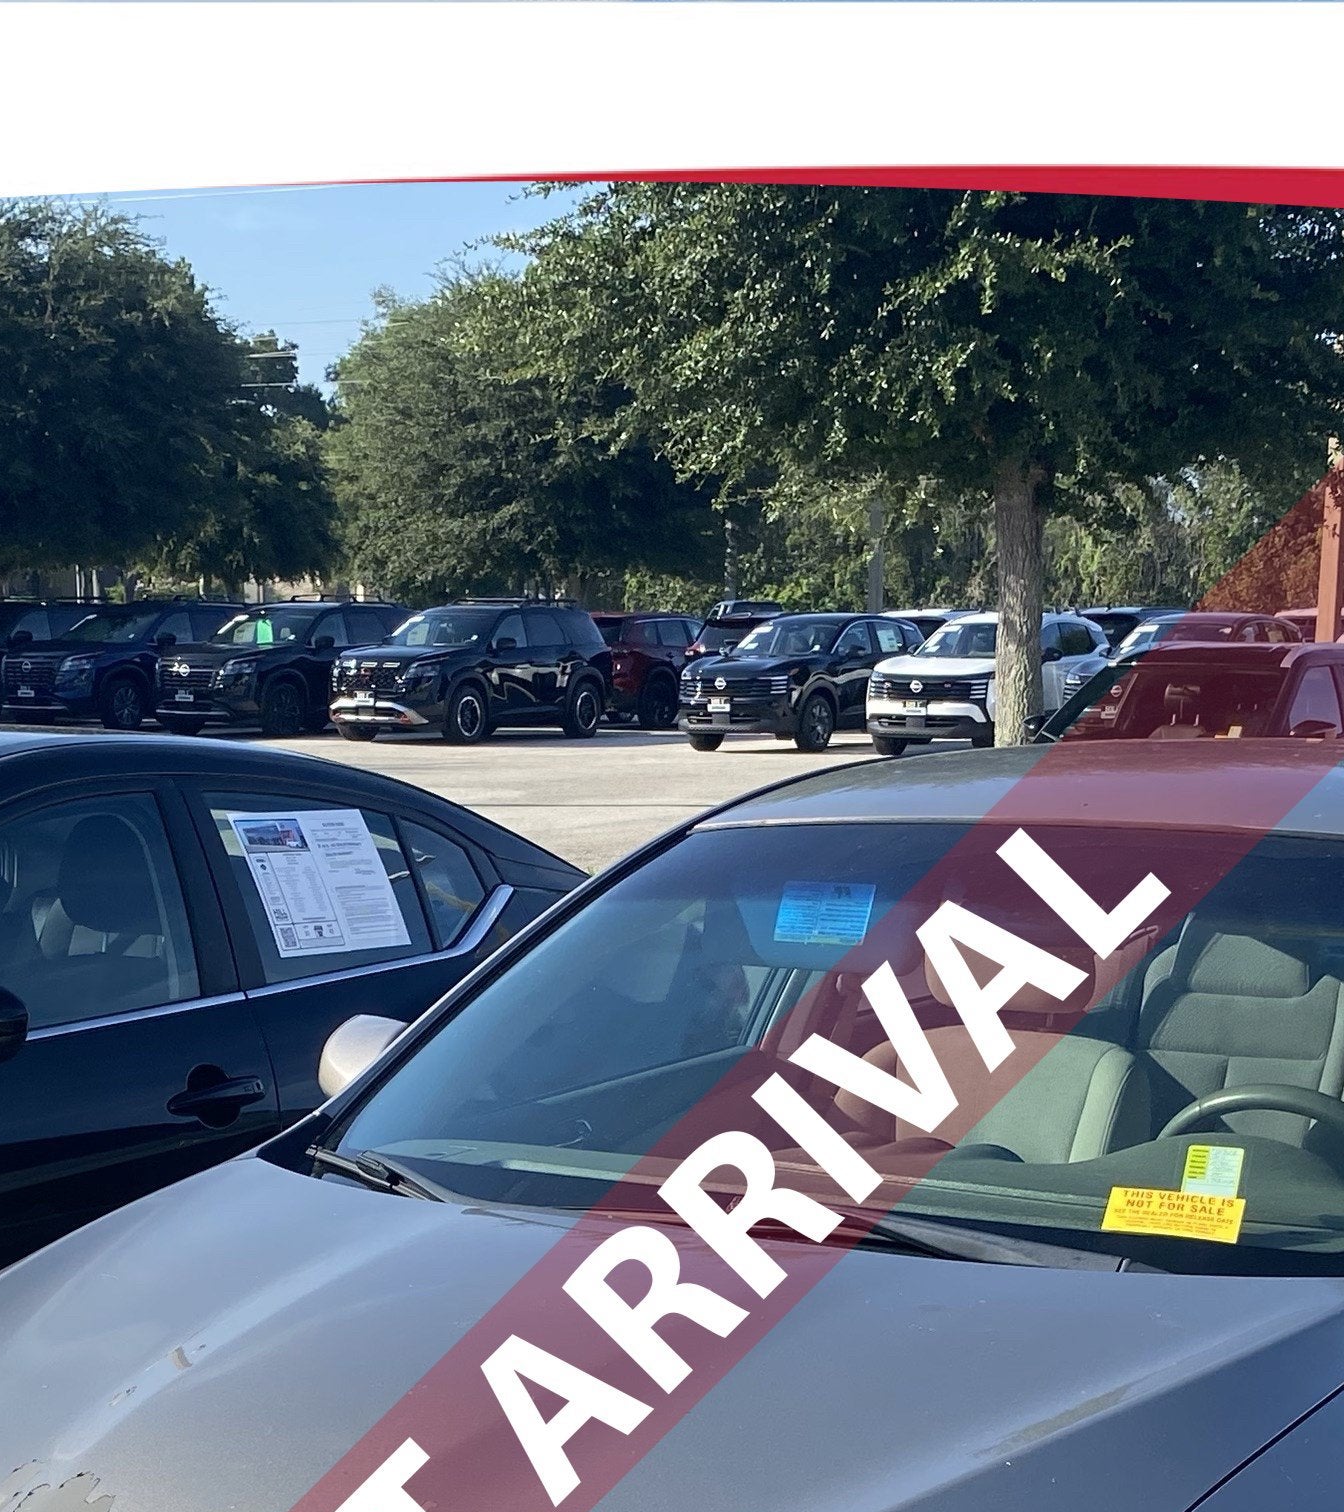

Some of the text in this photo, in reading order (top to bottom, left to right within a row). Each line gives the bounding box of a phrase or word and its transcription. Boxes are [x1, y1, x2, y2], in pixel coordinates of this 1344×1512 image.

[1123, 1189, 1234, 1208] THIS VEHICLE IS
[1126, 1199, 1225, 1216] NOT FOR SALE
